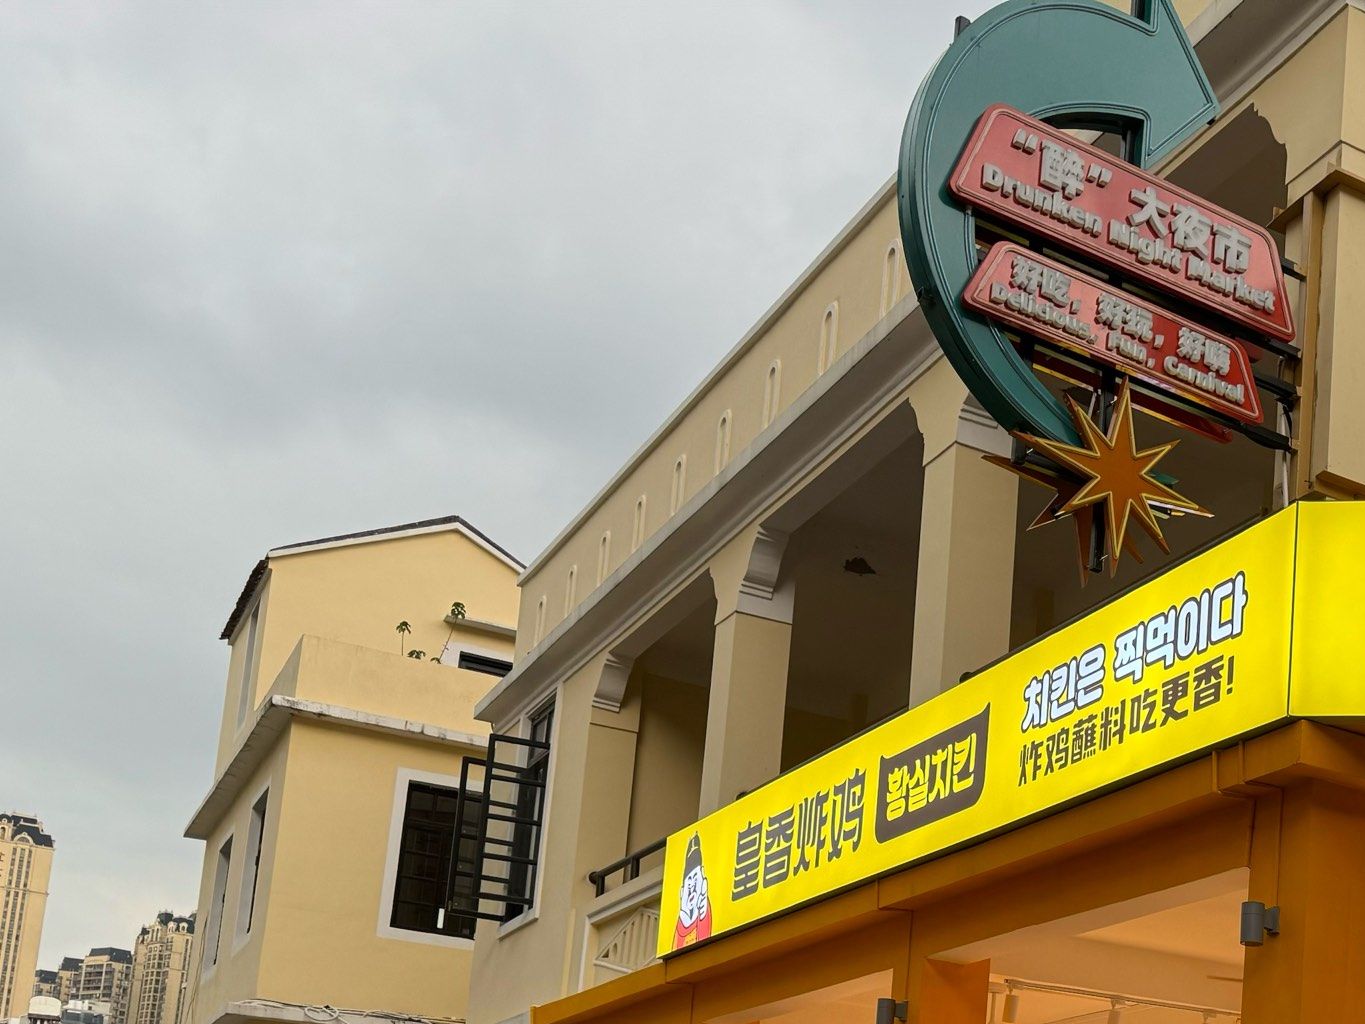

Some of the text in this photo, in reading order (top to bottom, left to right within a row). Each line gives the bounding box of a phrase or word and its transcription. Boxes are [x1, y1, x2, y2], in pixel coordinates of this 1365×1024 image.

[981, 163, 1275, 314] Drunken Night Market
[989, 282, 1245, 405] Delicious, Fun, Carnival
[1021, 570, 1248, 733] 치킨은 찍먹이다
[732, 767, 866, 901] 皇香炸鸡
[885, 732, 978, 822] 황실치킨
